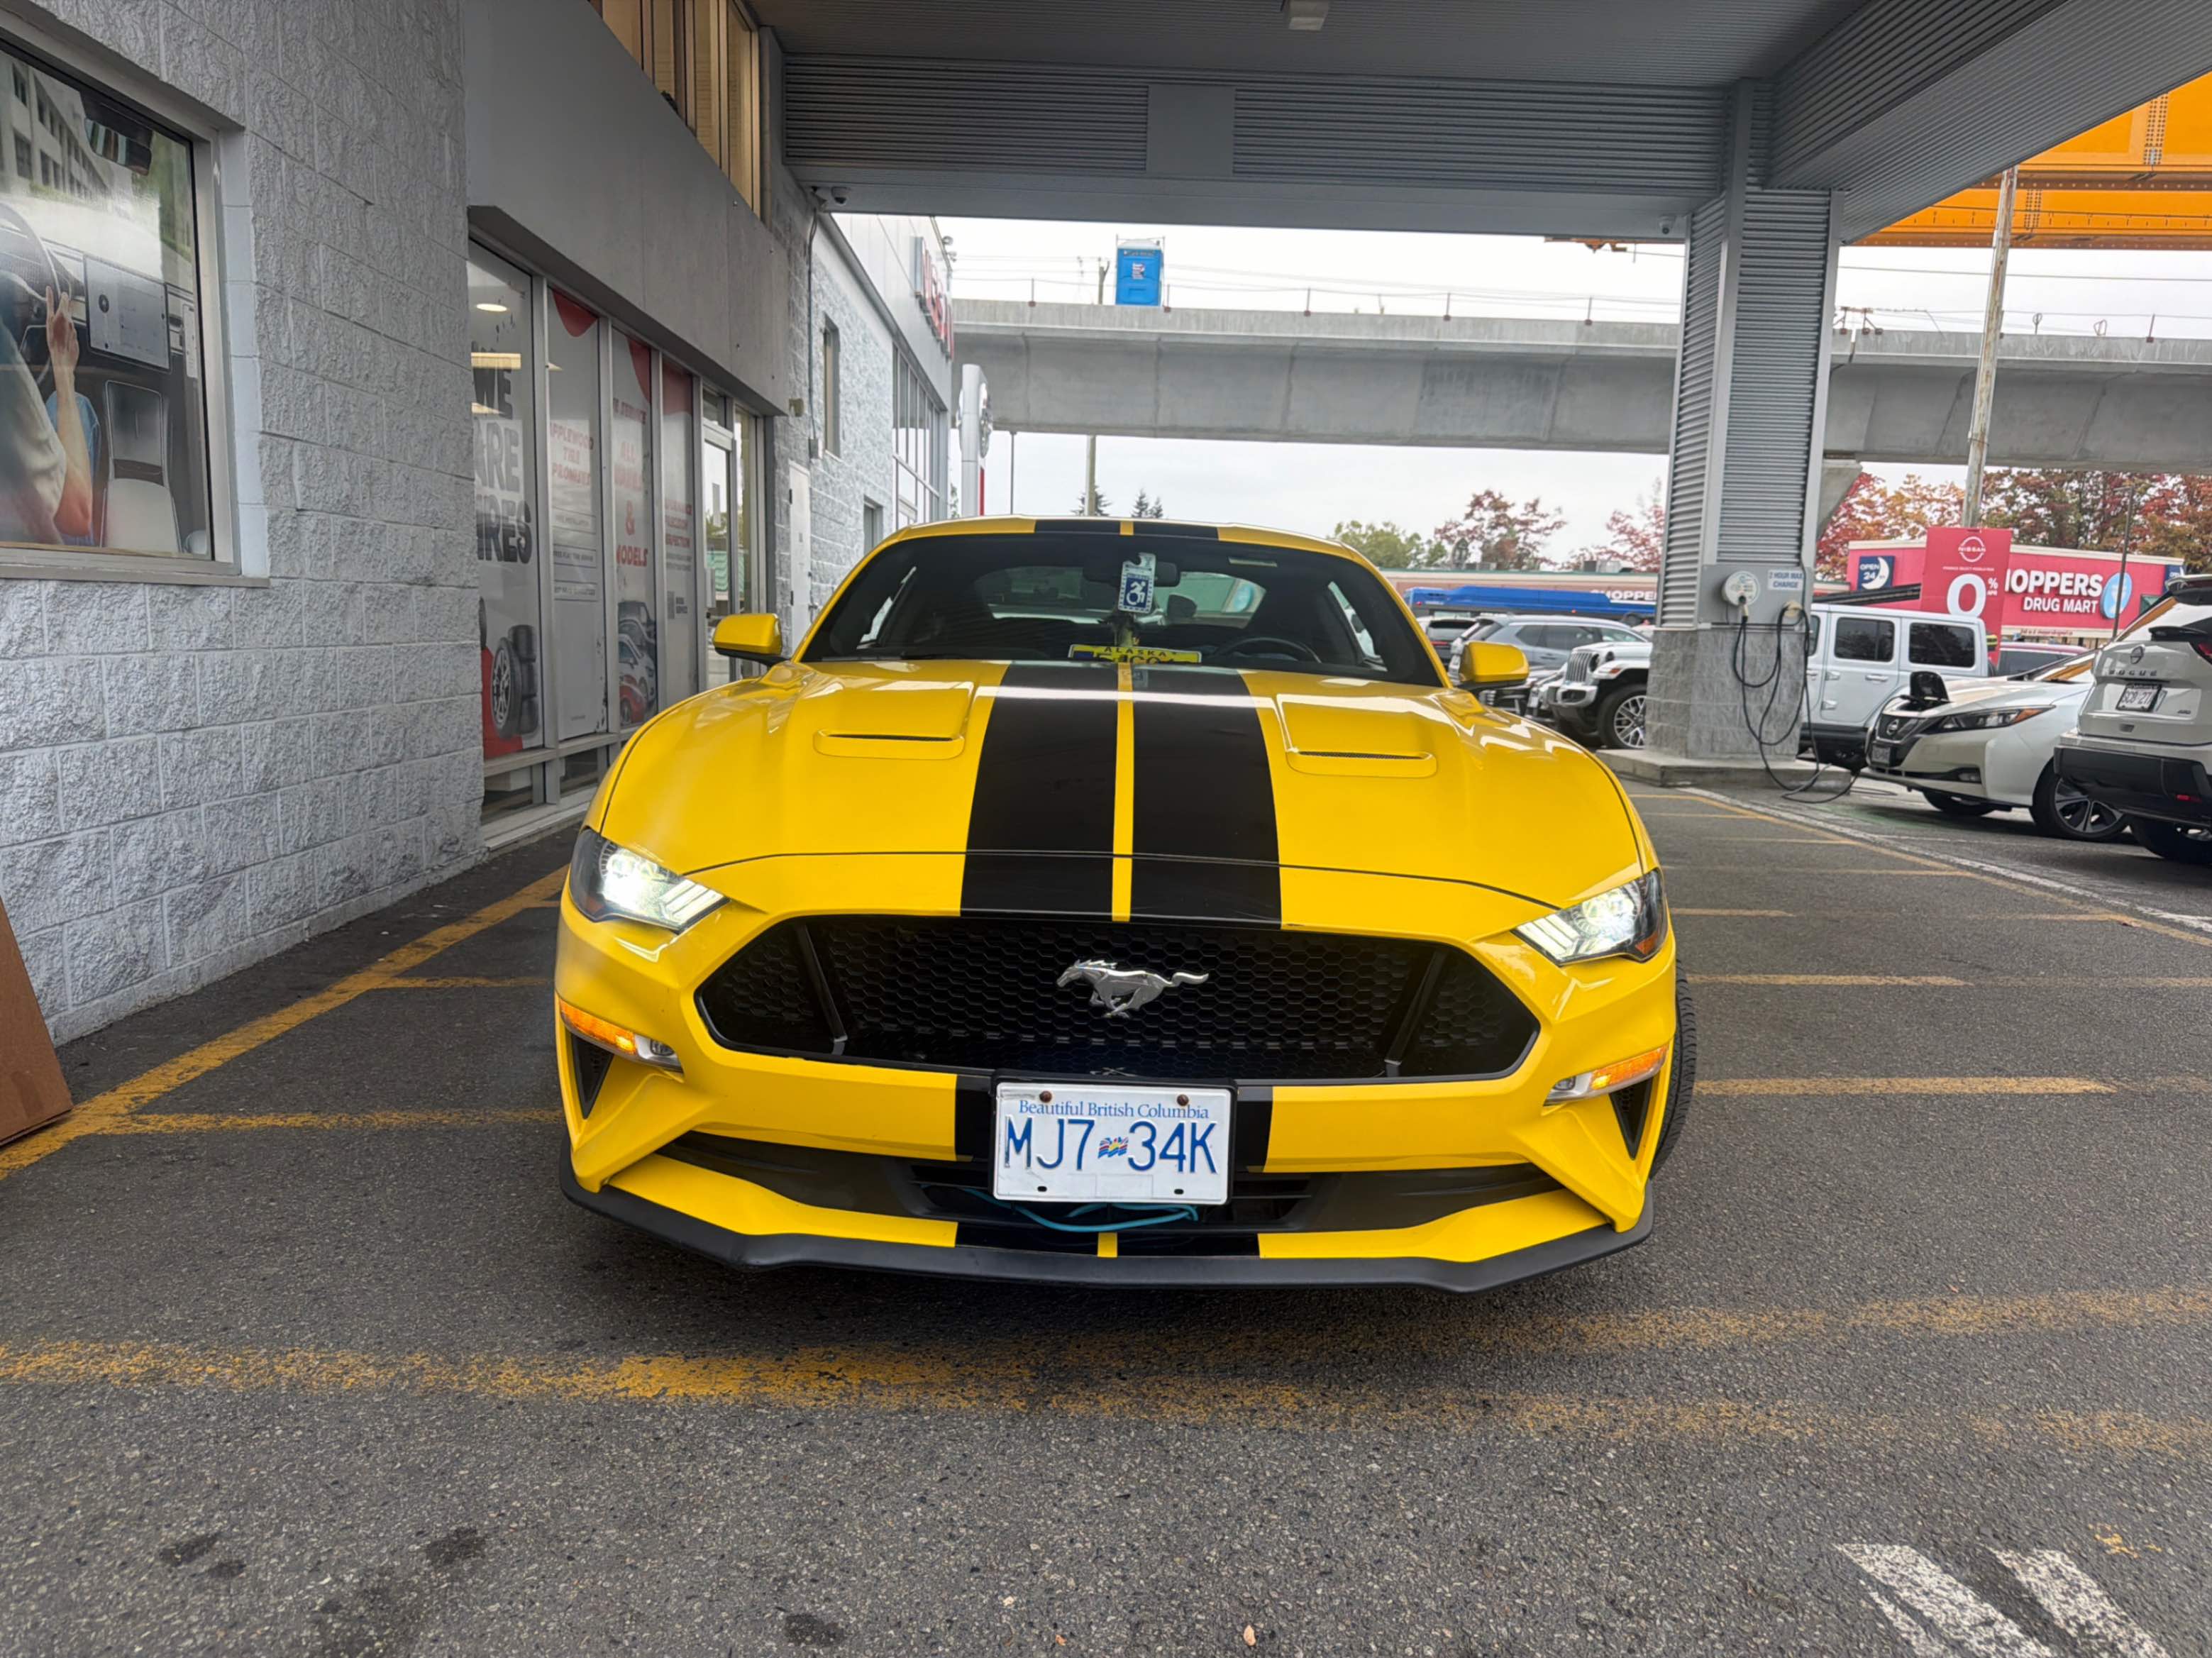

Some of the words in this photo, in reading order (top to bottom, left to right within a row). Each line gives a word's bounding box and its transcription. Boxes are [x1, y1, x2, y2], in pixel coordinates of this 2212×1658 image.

[626, 499, 636, 536] &
[475, 494, 533, 565] IRES
[1863, 572, 1875, 580] 24
[2005, 568, 2103, 597] OPPERS
[1590, 589, 1657, 601] OPPE
[2023, 597, 2060, 612] DRUG
[2063, 599, 2098, 614] MART
[1104, 646, 1167, 657] ALASKA
[1019, 1100, 1084, 1116] Beautiful
[1088, 1102, 1134, 1117] British
[1137, 1103, 1209, 1119] Columbia
[1004, 1116, 1095, 1171] MJ7
[1127, 1121, 1218, 1173] 34K
